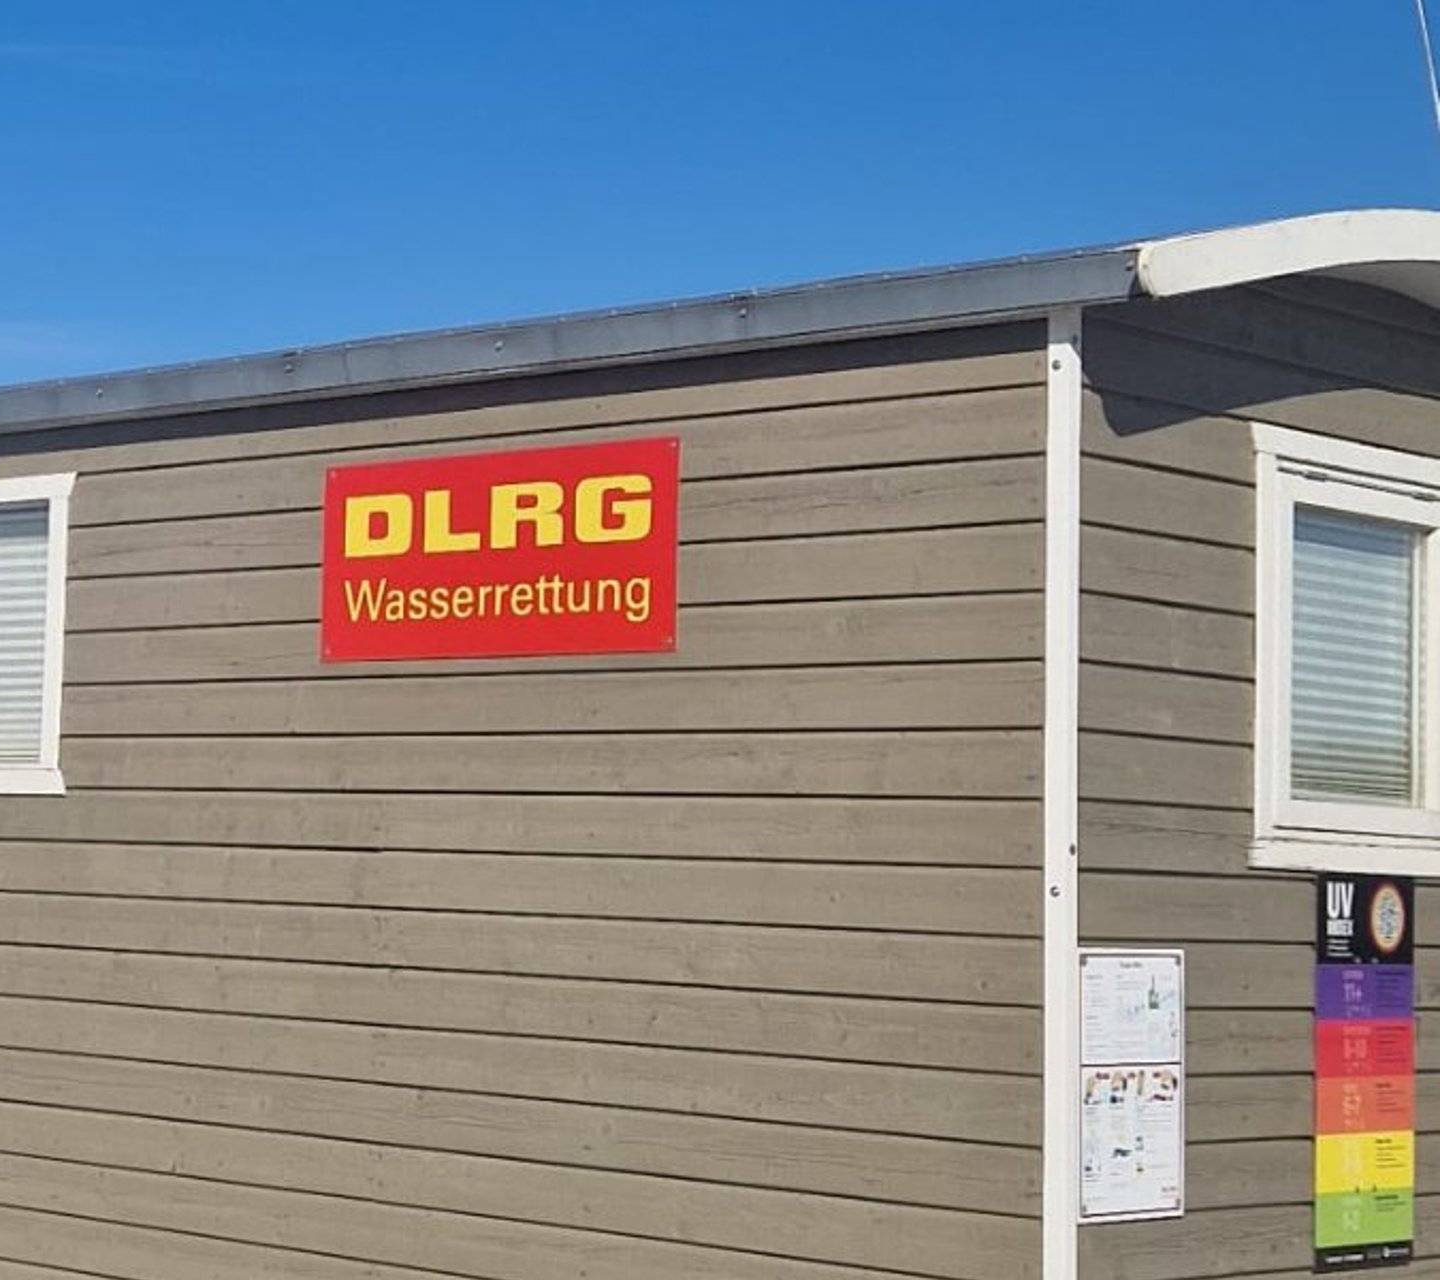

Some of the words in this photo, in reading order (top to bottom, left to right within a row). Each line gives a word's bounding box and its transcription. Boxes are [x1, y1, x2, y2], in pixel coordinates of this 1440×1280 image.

[345, 474, 653, 558] DLRG
[344, 574, 652, 622] Wasserrettung
[1327, 881, 1353, 918] UV
